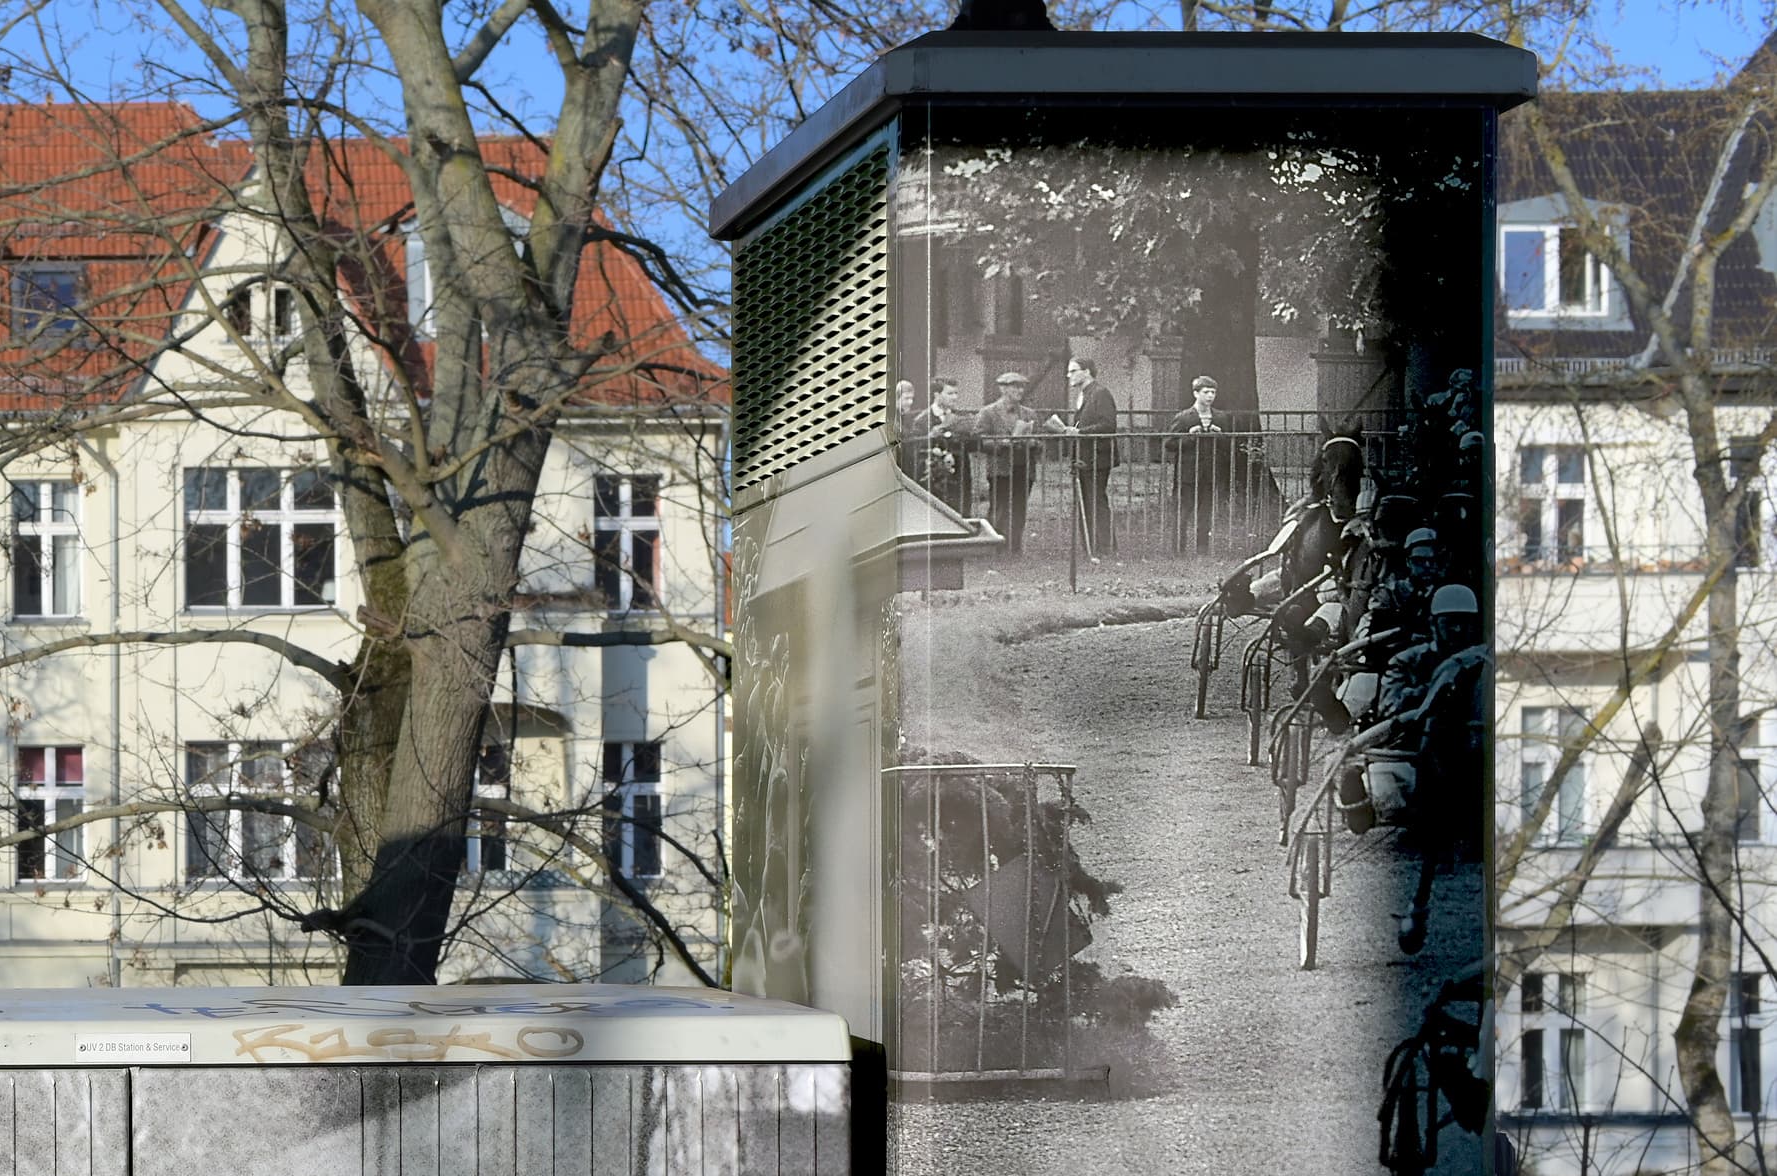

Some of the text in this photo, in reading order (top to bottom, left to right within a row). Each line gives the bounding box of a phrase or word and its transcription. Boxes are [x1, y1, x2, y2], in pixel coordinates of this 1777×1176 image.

[86, 1042, 180, 1052] UV 2 DB Station & Service
